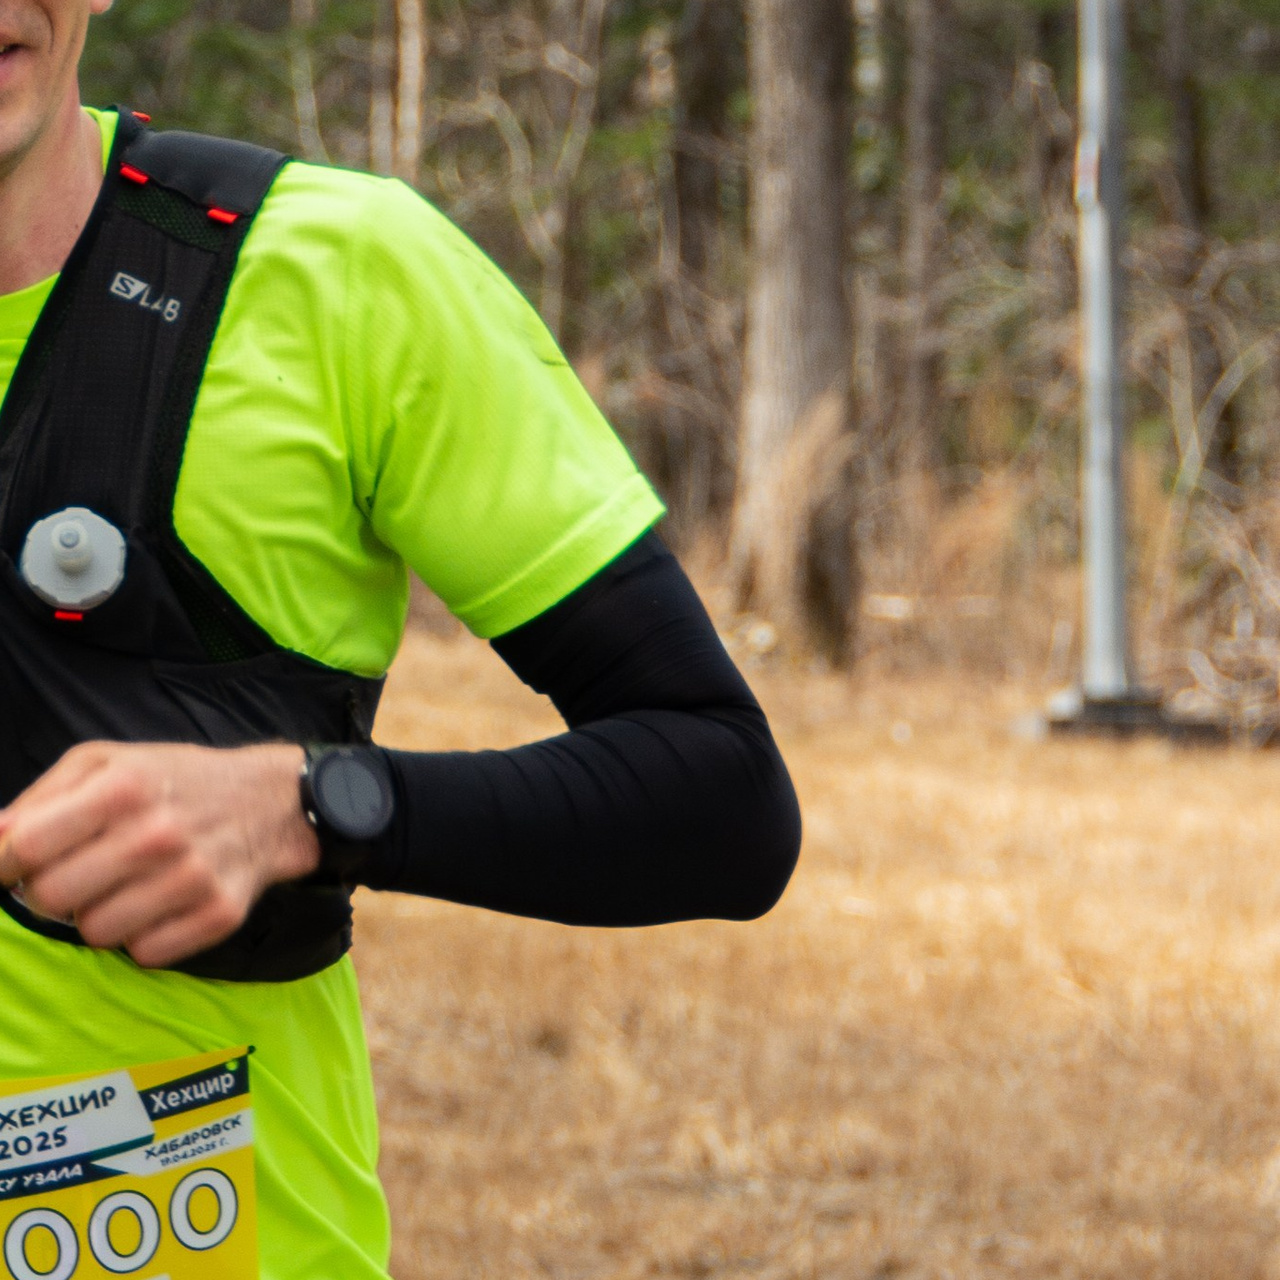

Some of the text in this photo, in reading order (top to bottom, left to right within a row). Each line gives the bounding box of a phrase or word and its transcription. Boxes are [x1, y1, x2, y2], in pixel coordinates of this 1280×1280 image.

[149, 1073, 235, 1113] Хехцир
[145, 1115, 242, 1159] ХАБАРОВСК
[23, 1164, 83, 1187] УЗАЛА
